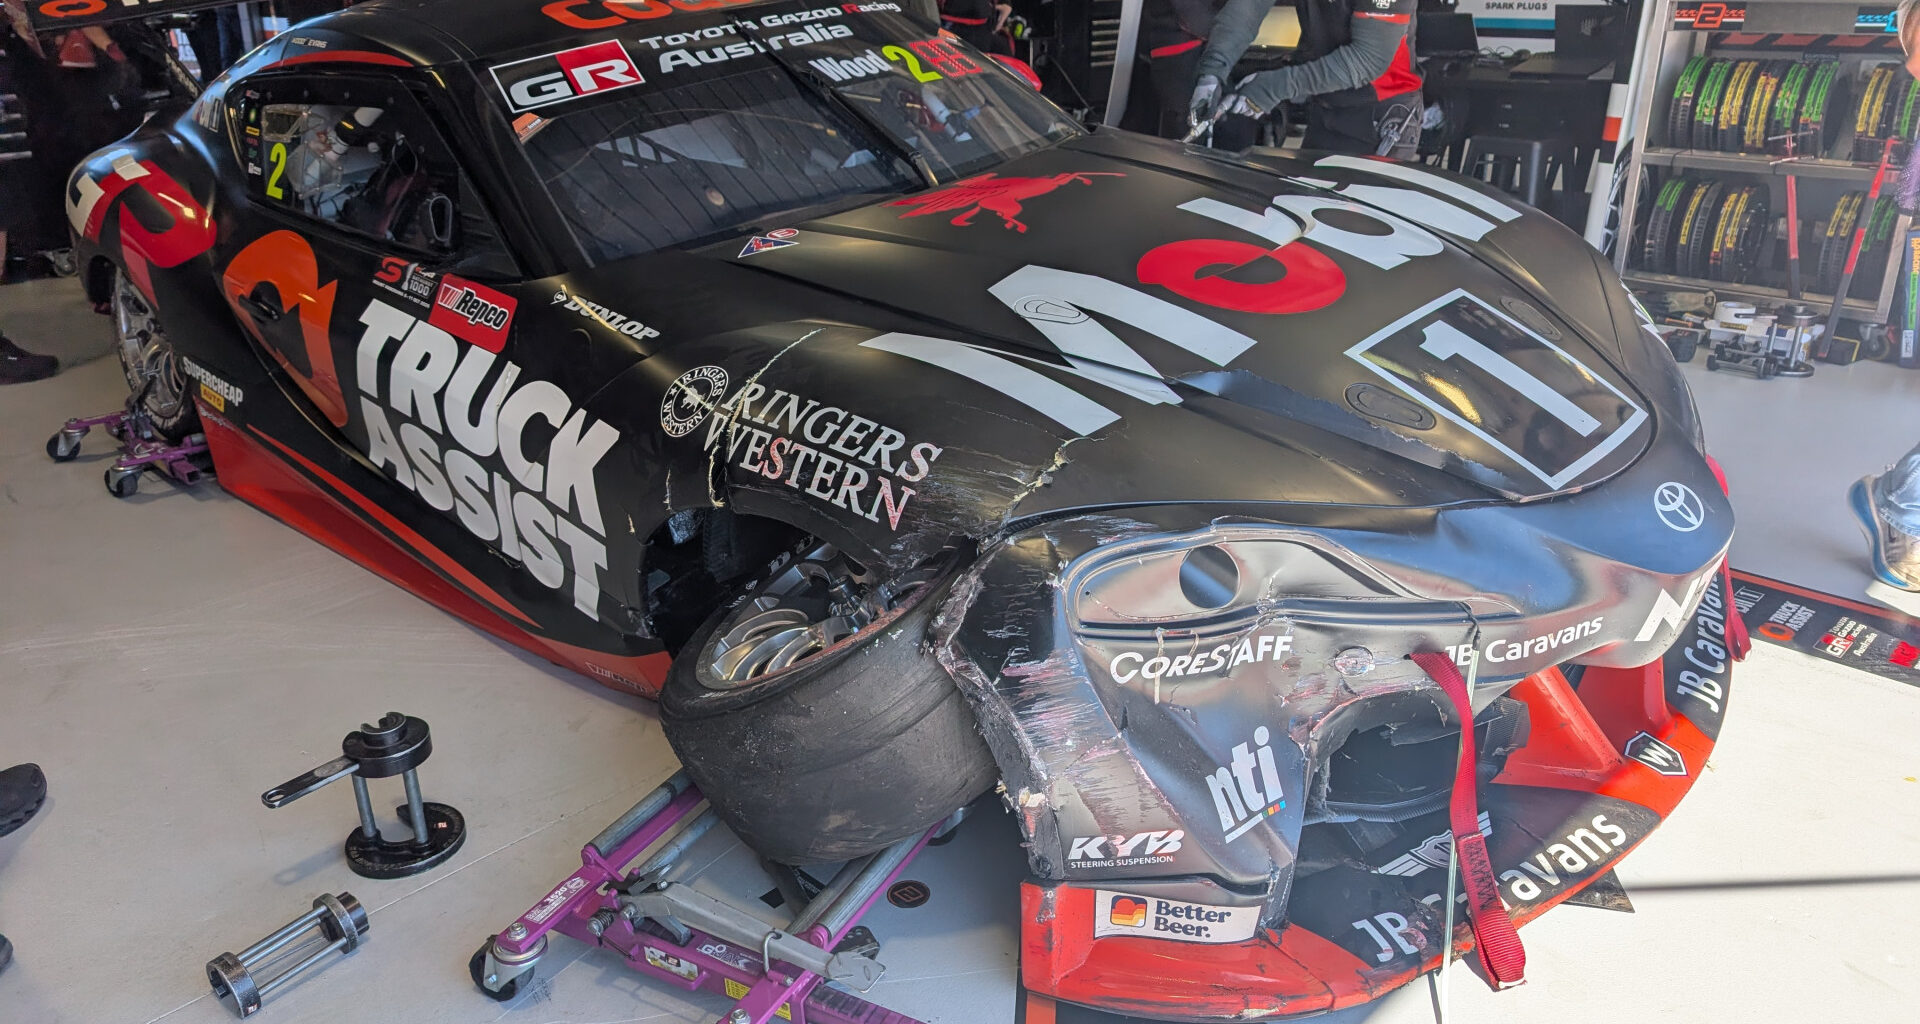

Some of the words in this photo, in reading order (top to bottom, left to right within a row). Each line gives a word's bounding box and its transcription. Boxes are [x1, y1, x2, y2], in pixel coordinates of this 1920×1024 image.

[639, 20, 759, 49] TOYOTA
[760, 7, 843, 28] GAZOO
[842, 1, 902, 16] Racing
[1485, 1, 1514, 10] SPARK
[1516, 2, 1548, 11] PLUGS
[658, 23, 854, 73] Australia
[808, 49, 893, 82] Wood
[882, 45, 943, 83] 2
[510, 59, 637, 106] GR
[266, 142, 287, 200] 2
[409, 279, 430, 296] 1000
[858, 154, 1524, 436] Mobil
[1418, 319, 1602, 438] 1
[455, 288, 509, 330] Repco
[563, 295, 660, 340] DUNLOP
[183, 356, 243, 407] SUPERCHEAP
[203, 388, 222, 407] AUTO
[682, 367, 725, 398] RINGERS
[357, 298, 620, 537] TRUCK
[661, 399, 704, 434] WESTERN
[721, 381, 943, 483] RINGERS
[703, 411, 917, 532] WESTERN
[360, 396, 608, 622] ASSIST
[1768, 600, 1801, 624] TRUCK
[1784, 605, 1816, 631] ASSIST
[1445, 643, 1474, 666] JB
[1485, 616, 1603, 663] Caravans
[1853, 632, 1878, 657] Australia
[1677, 670, 1723, 713] JB
[1638, 741, 1673, 767] W
[1205, 725, 1284, 832] nti
[1068, 829, 1185, 860] KYB
[1070, 859, 1114, 869] STEERING
[1116, 855, 1174, 867] SUSPENSION
[1154, 916, 1211, 938] Beer.
[1155, 900, 1232, 923] Better
